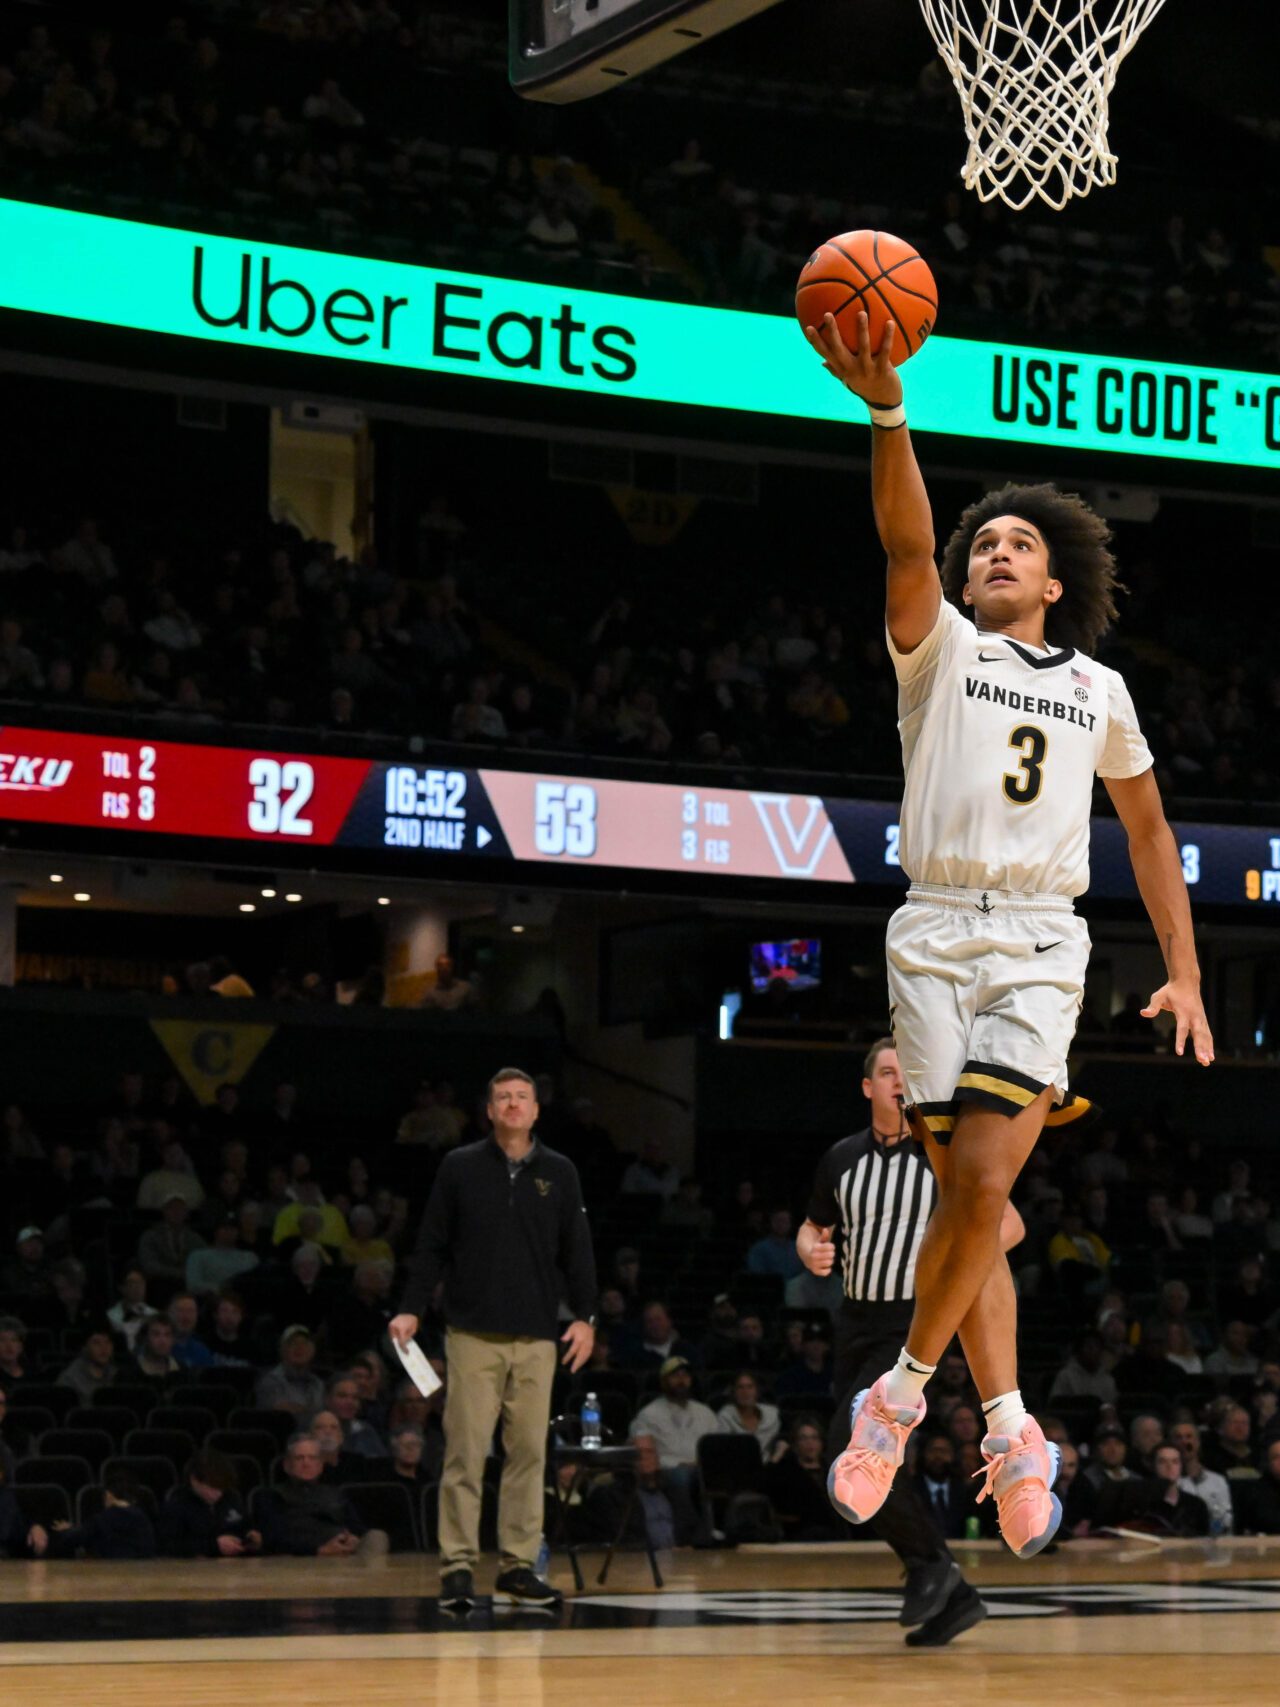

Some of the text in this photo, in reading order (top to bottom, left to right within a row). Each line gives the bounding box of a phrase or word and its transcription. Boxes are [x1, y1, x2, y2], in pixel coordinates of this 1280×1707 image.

[192, 245, 637, 383] Uber Eats
[993, 354, 1079, 431] USE
[1096, 367, 1218, 445] CODE
[966, 677, 1096, 733] VANDERBILT
[103, 747, 156, 780] TOL 2
[1002, 723, 1049, 806] 3
[103, 786, 155, 821] FLS 3
[248, 758, 314, 836] 32
[385, 767, 467, 819] 16:52
[534, 781, 598, 857] 53
[682, 791, 730, 827] 3 TOL
[384, 817, 466, 850] 2ND HALF
[682, 830, 730, 865] 3 FLS
[192, 1029, 235, 1077] C
